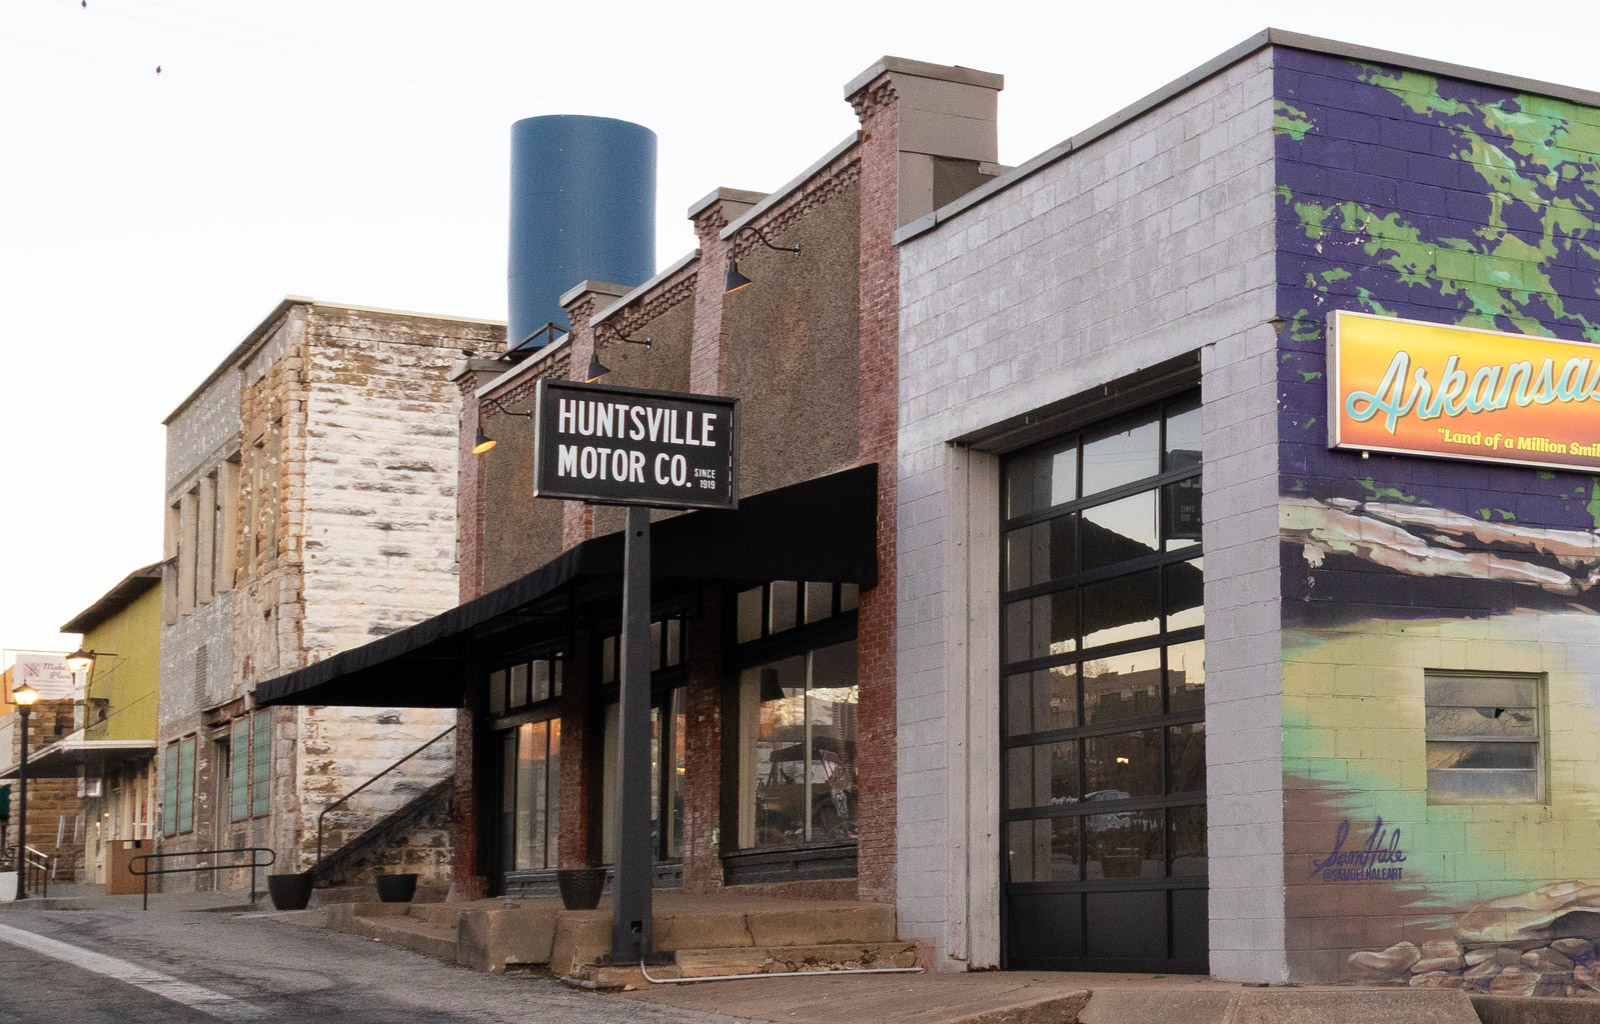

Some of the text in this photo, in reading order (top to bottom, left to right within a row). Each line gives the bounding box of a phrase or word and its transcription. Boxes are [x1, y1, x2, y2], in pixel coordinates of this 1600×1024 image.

[558, 398, 717, 447] HUNTSVILLE
[1484, 432, 1502, 450] of
[1504, 437, 1514, 449] a
[1516, 436, 1567, 454] Million
[557, 444, 692, 488] MOTOR CO.
[694, 467, 716, 479] SINCE
[699, 480, 716, 490] 1919
[1323, 867, 1403, 882] @SAMUELHALEART
